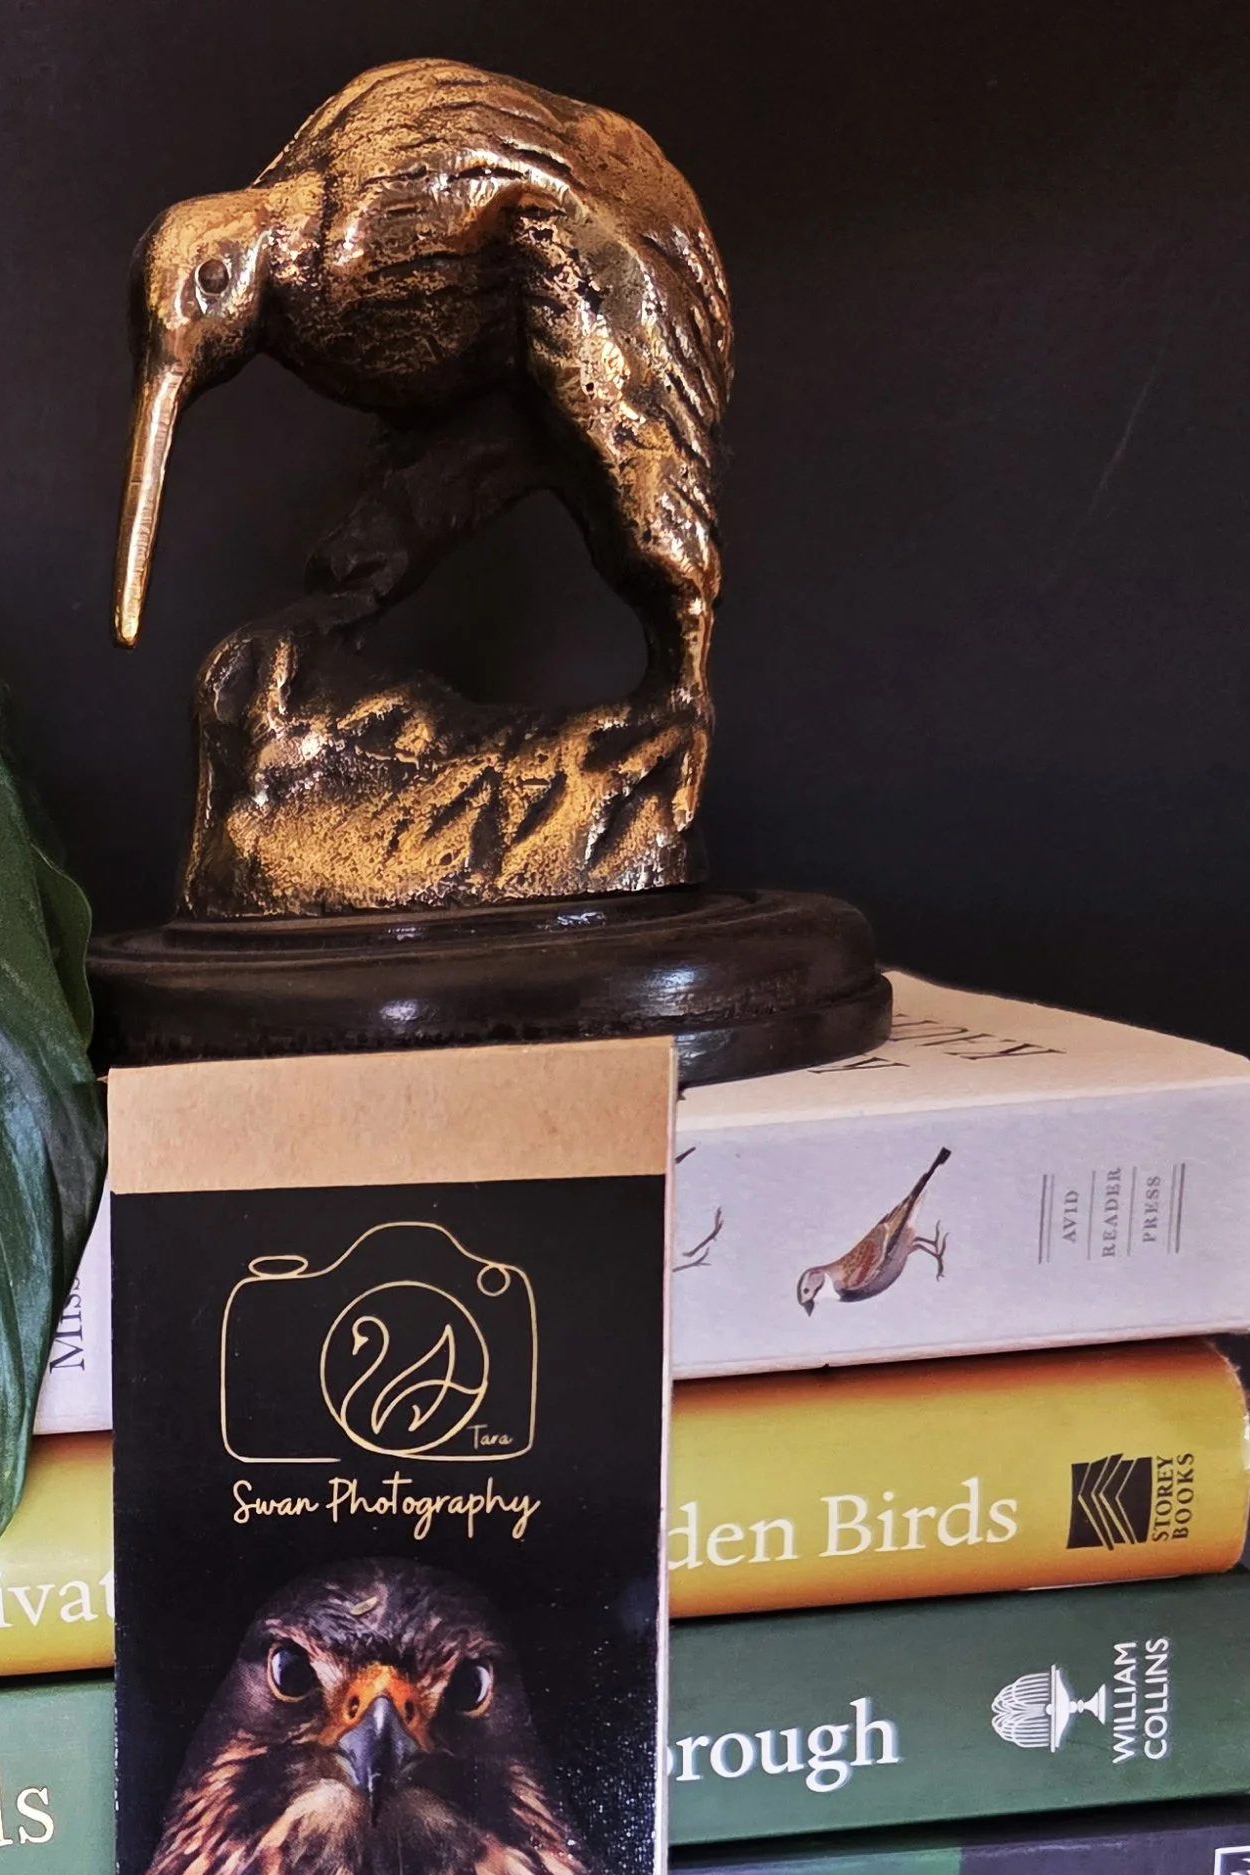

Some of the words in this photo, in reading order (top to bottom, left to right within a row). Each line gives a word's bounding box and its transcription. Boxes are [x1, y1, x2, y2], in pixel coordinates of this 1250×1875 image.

[1061, 1190, 1080, 1243] AVID
[1101, 1167, 1122, 1258] READER
[1141, 1175, 1161, 1243] PRESS
[466, 1423, 514, 1450] Tara
[232, 1479, 319, 1524] Swan
[325, 1470, 542, 1540] Photography
[819, 1476, 1018, 1558] Birds
[1152, 1455, 1174, 1542] STOREY
[1172, 1452, 1195, 1540] BOOKS
[1111, 1641, 1138, 1764] WILLIAM
[1143, 1637, 1170, 1760] COLLINS
[667, 1696, 902, 1793] rough
